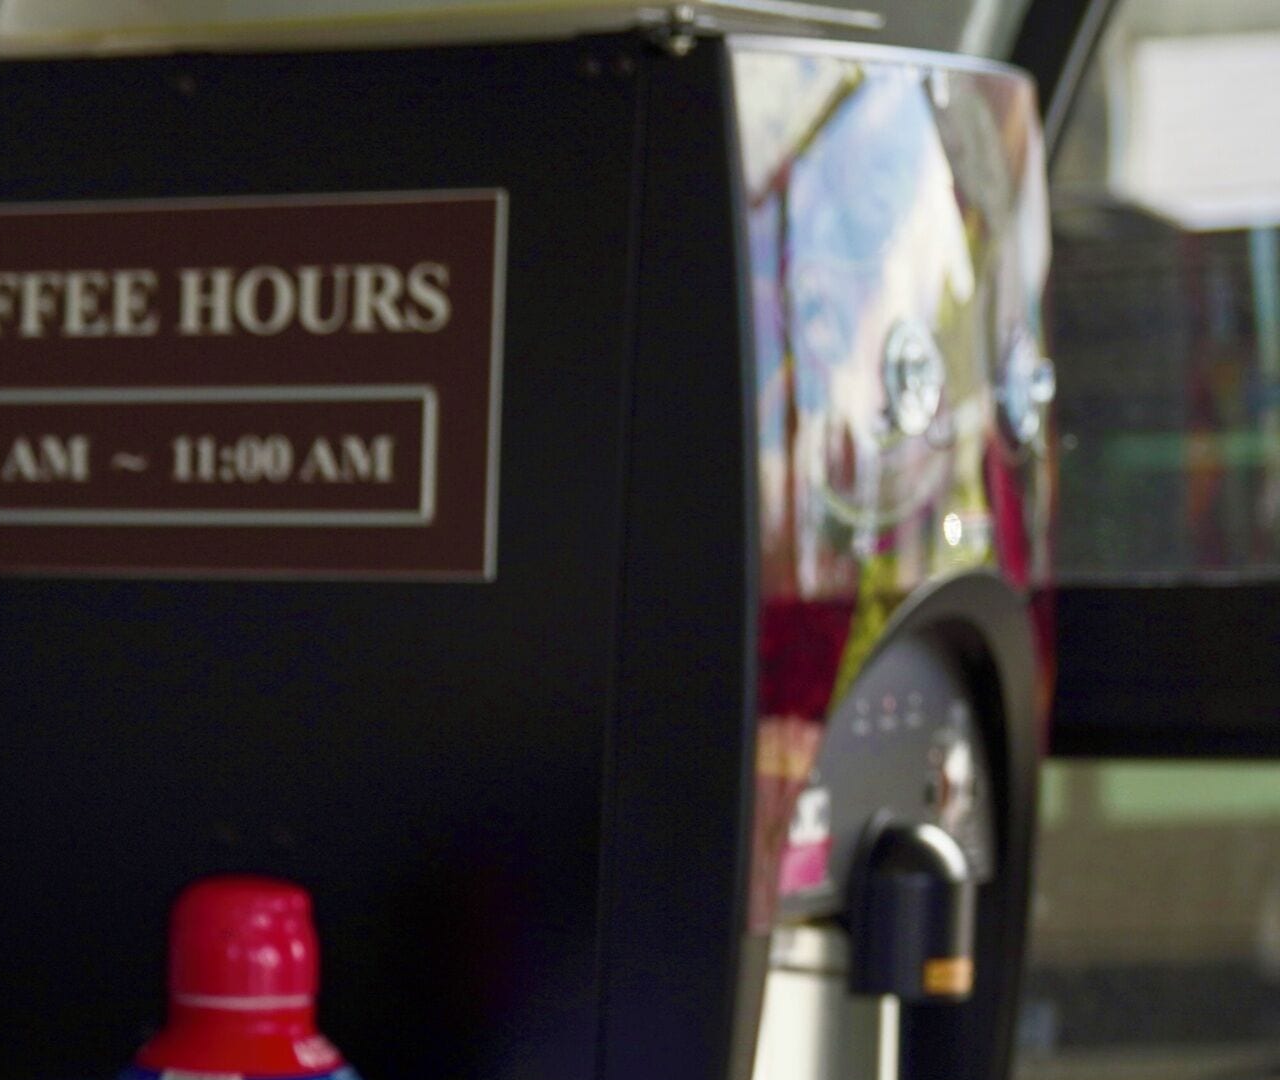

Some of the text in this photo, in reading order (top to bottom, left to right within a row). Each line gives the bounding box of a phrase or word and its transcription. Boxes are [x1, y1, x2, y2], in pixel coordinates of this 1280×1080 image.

[178, 261, 453, 336] HOURS
[1, 434, 92, 483] AM
[170, 434, 294, 483] 11:00
[299, 434, 394, 483] AM
